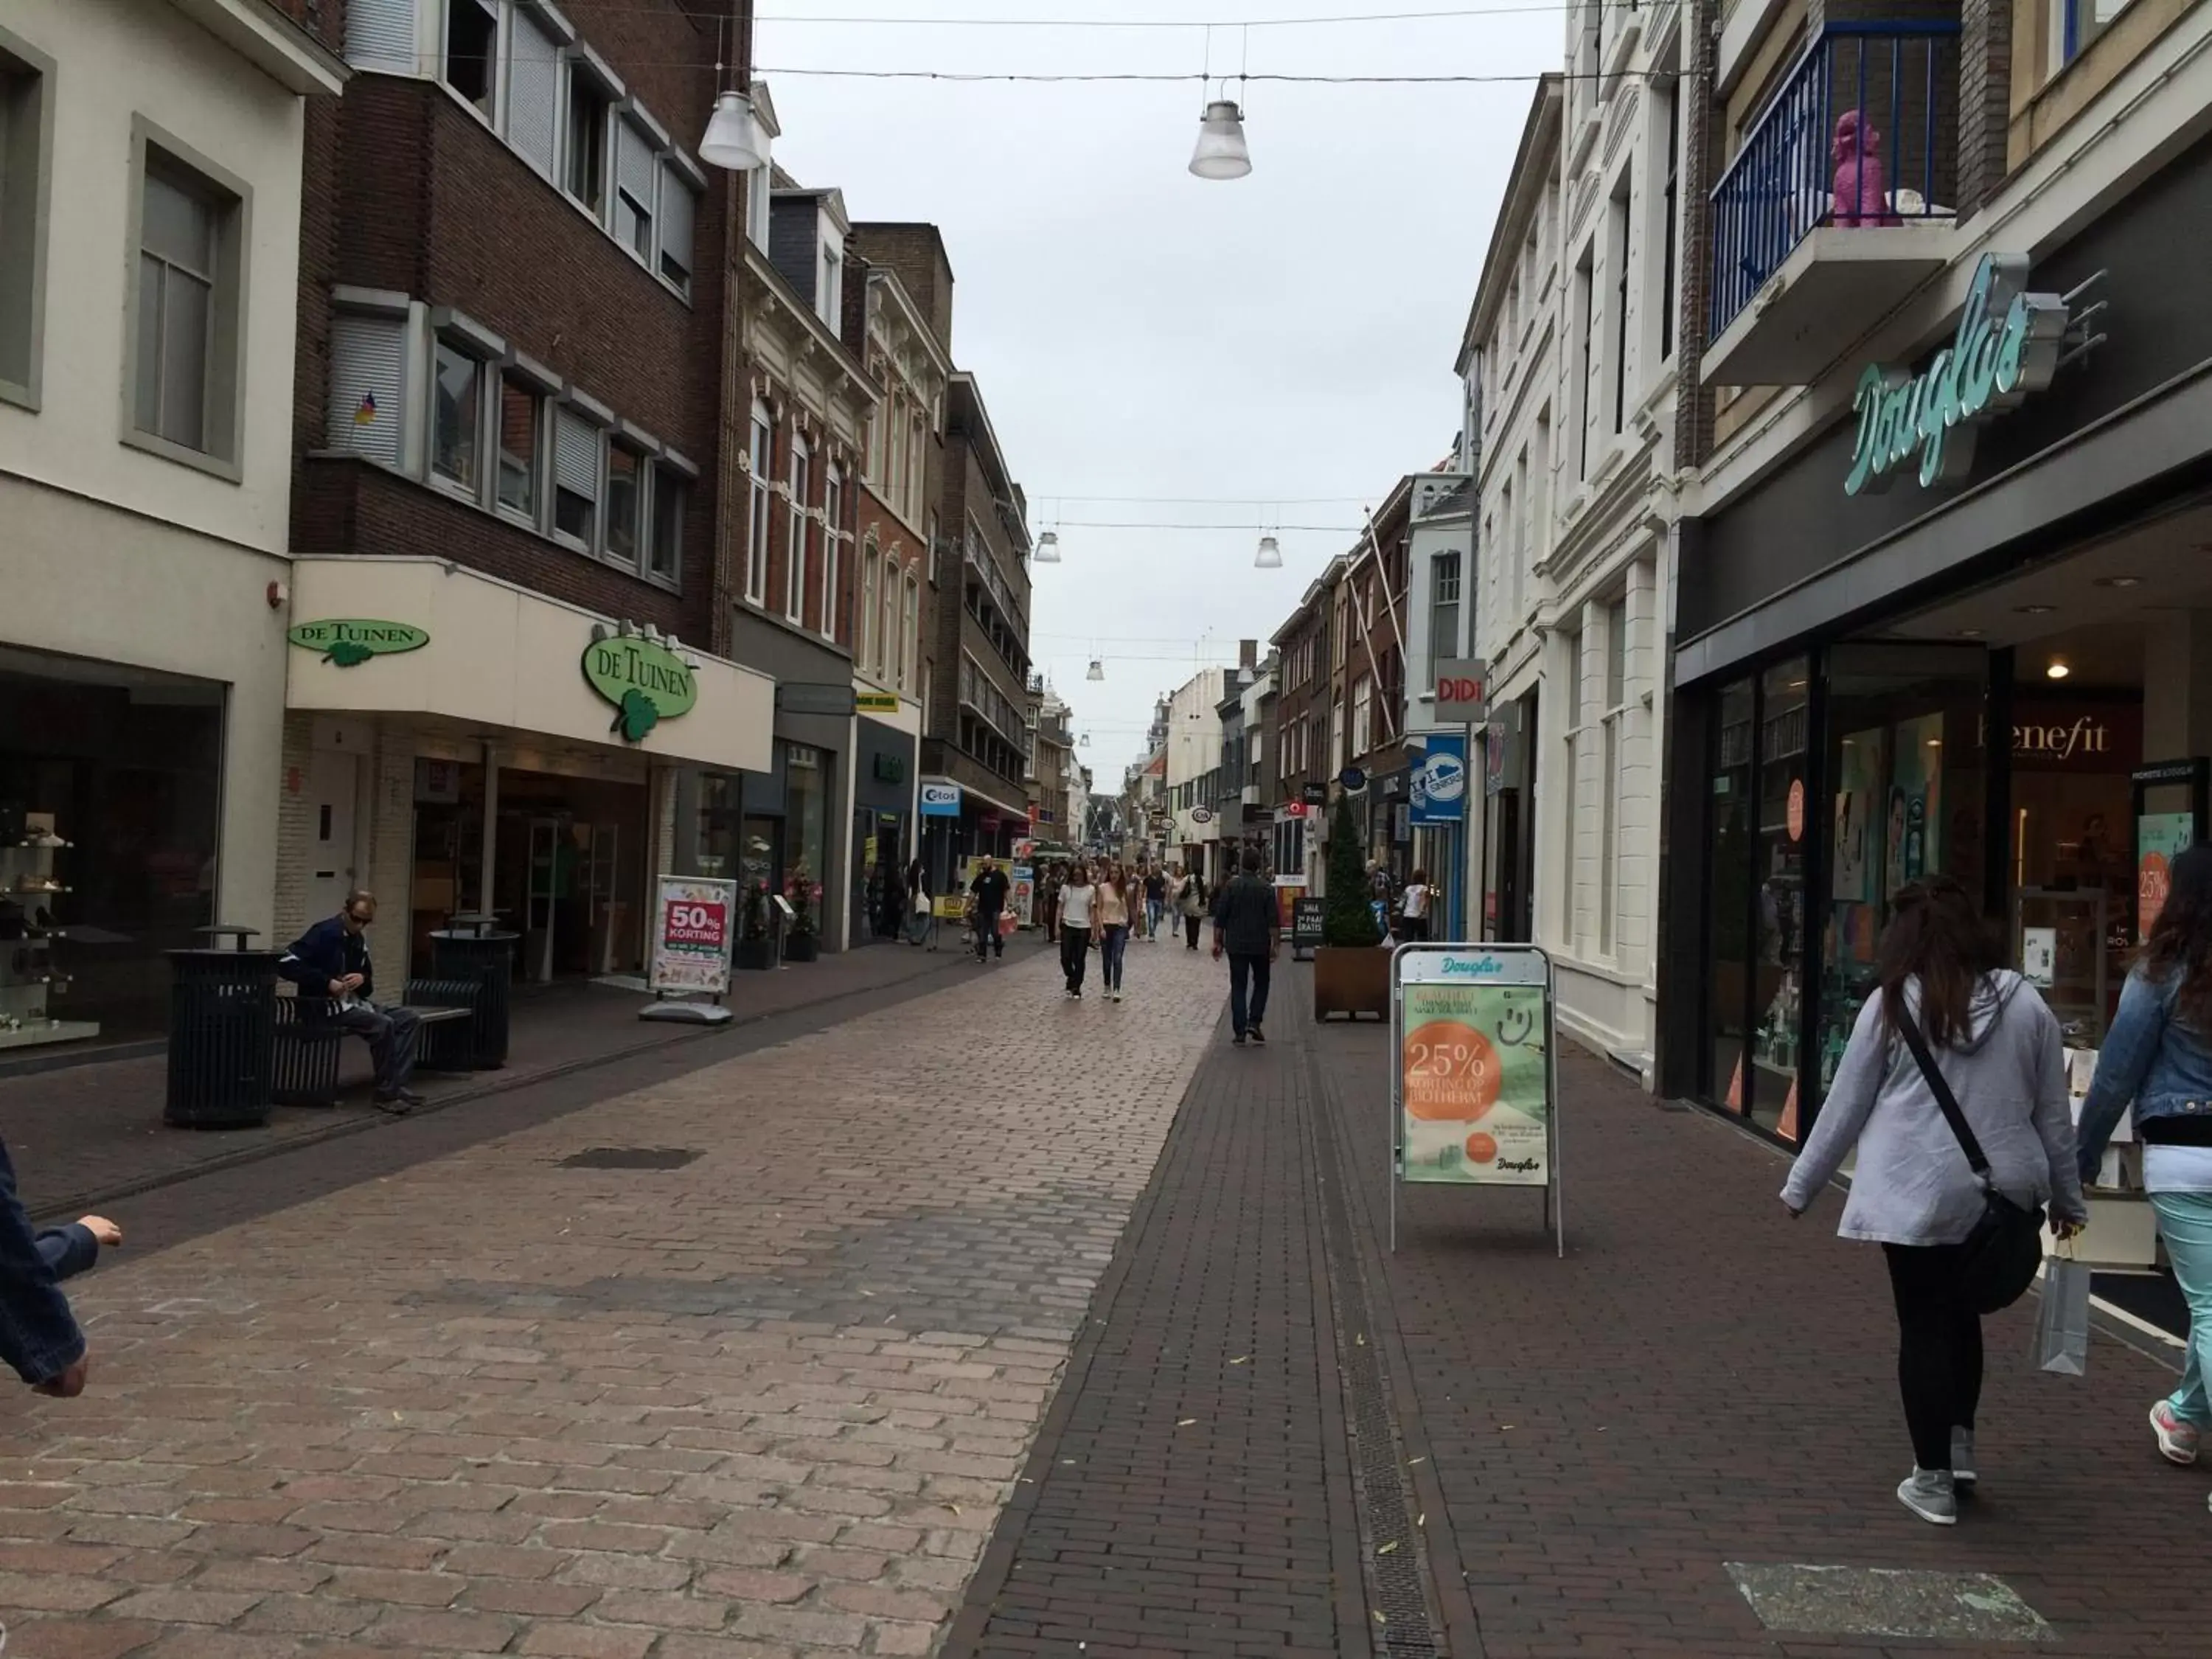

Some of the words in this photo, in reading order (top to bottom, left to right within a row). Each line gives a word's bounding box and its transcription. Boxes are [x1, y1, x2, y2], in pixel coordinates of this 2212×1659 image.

[1845, 251, 2029, 496] Douglas
[301, 627, 327, 640] DE
[330, 623, 414, 642] TUINEN
[597, 648, 621, 679] DE
[625, 646, 690, 698] TUINEN
[670, 905, 720, 930] 50%
[669, 928, 720, 941] KORTING
[1409, 1043, 1485, 1077] 25%
